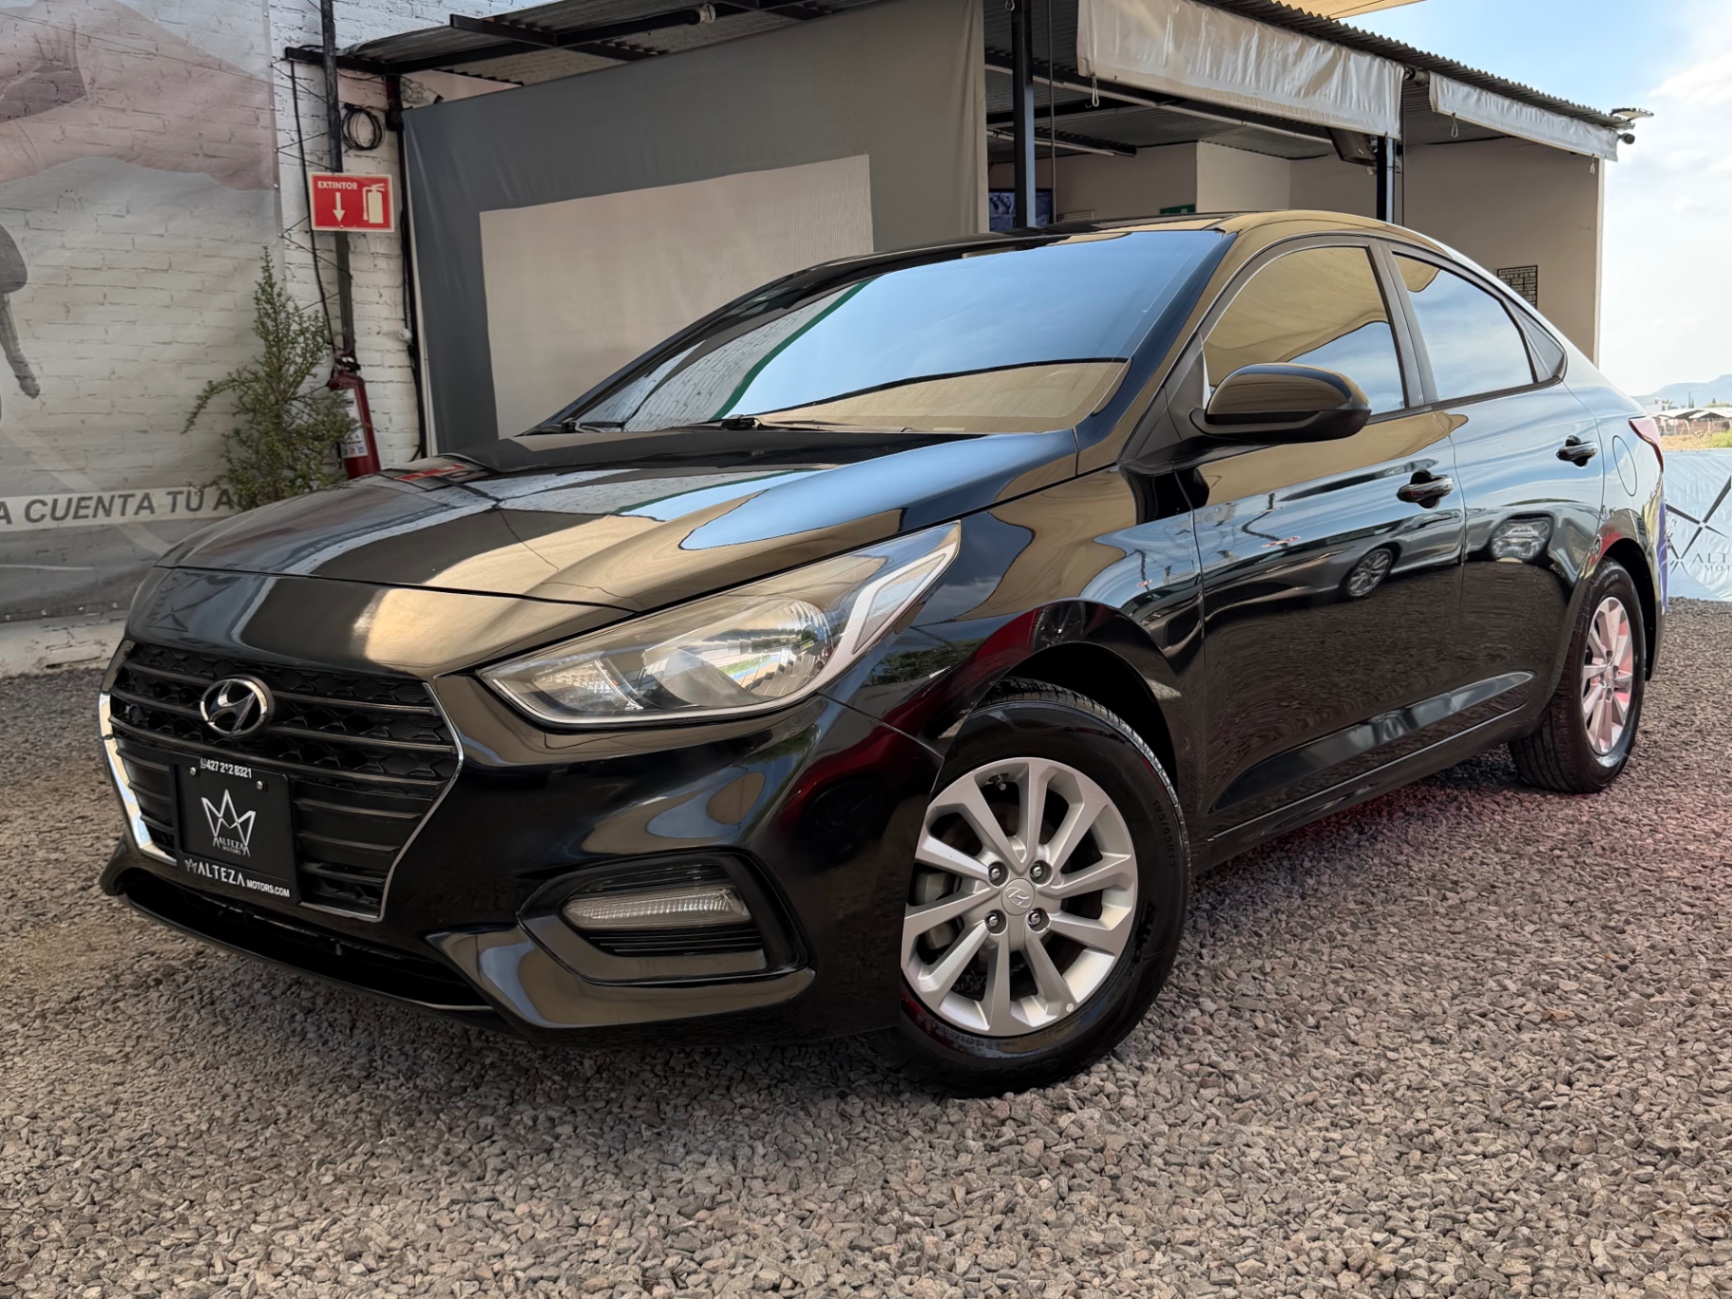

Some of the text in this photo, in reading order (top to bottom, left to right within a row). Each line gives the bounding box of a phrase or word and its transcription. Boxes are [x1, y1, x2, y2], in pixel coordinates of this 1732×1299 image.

[317, 181, 358, 190] EXTINTOR
[24, 492, 156, 523] CUENTA
[206, 759, 220, 772] 427
[218, 836, 245, 851] ALTEZA
[198, 861, 290, 898] ALTEZA MOTORS.COM
